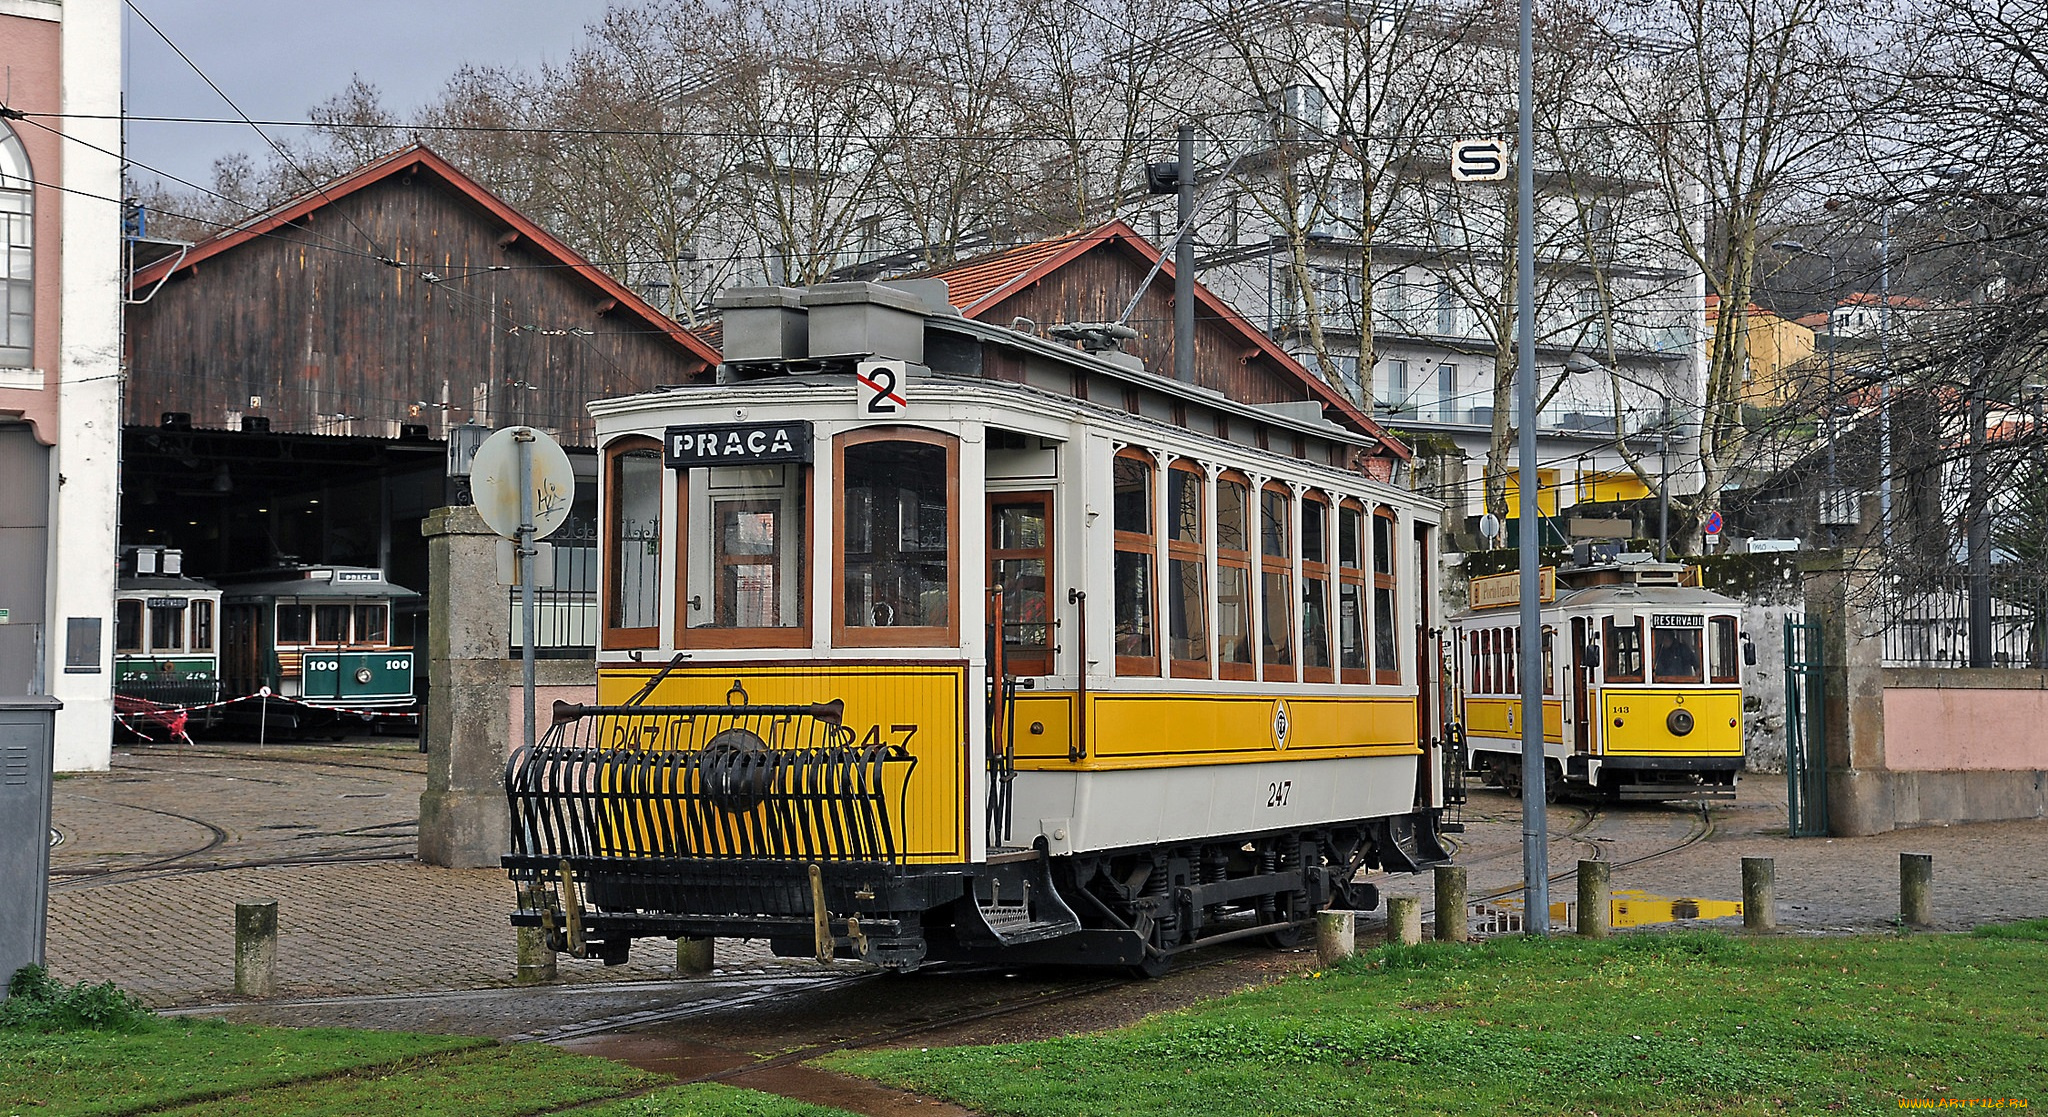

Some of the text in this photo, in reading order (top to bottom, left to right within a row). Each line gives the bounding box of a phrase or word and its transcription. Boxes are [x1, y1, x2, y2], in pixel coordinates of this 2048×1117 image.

[868, 367, 896, 413] 2
[673, 429, 793, 458] PRAÇA
[1654, 615, 1704, 626] RESERVADO
[309, 661, 338, 671] 100
[386, 660, 409, 670] 100
[1267, 781, 1292, 807] 247
